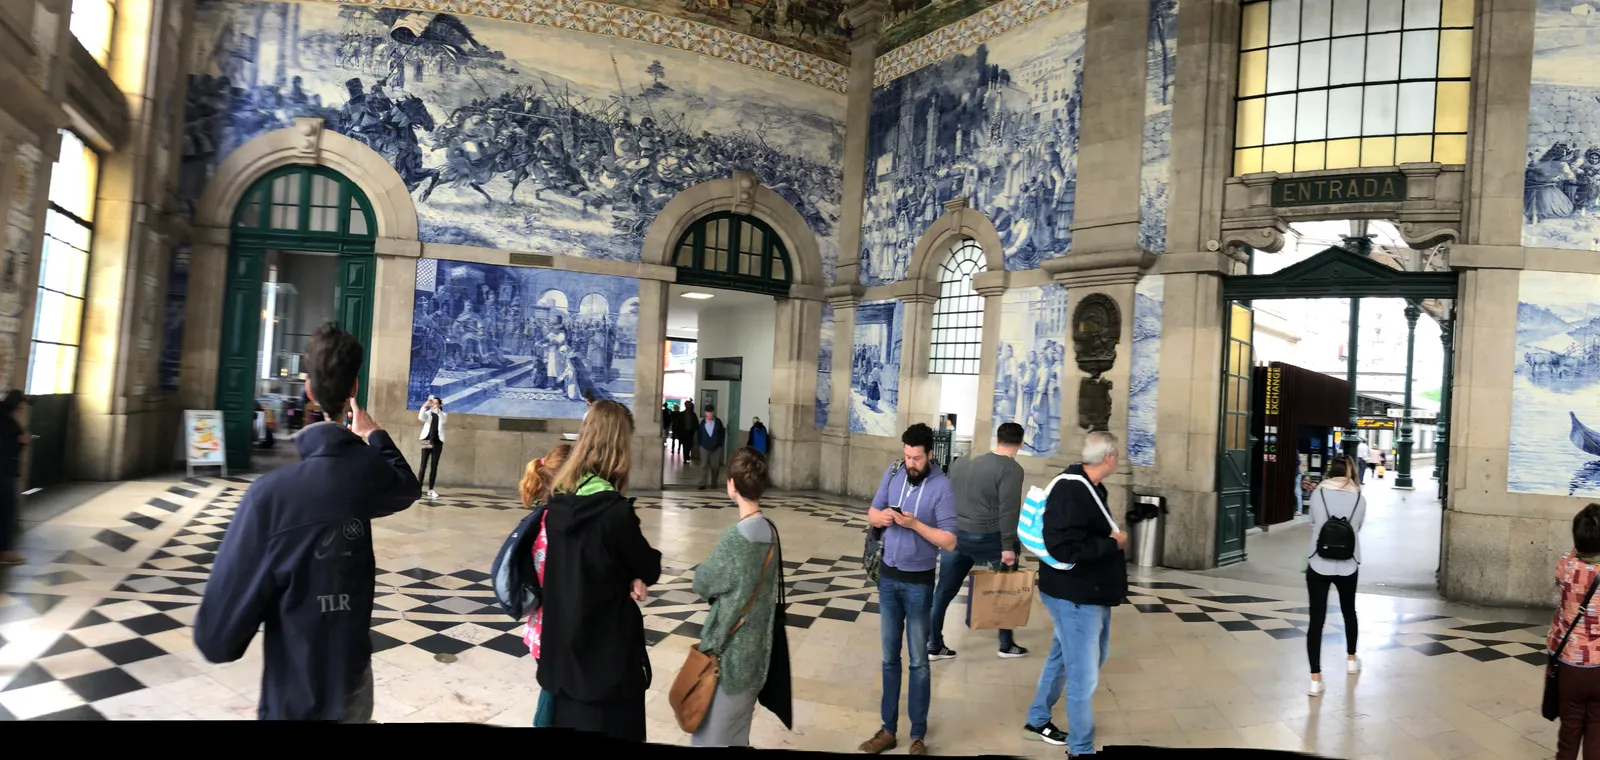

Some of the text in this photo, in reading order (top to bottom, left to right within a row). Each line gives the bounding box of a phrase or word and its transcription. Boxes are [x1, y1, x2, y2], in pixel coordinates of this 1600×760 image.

[1283, 178, 1395, 202] ENTRADA
[1271, 367, 1281, 415] EXCHANGE
[317, 593, 352, 613] TLR
